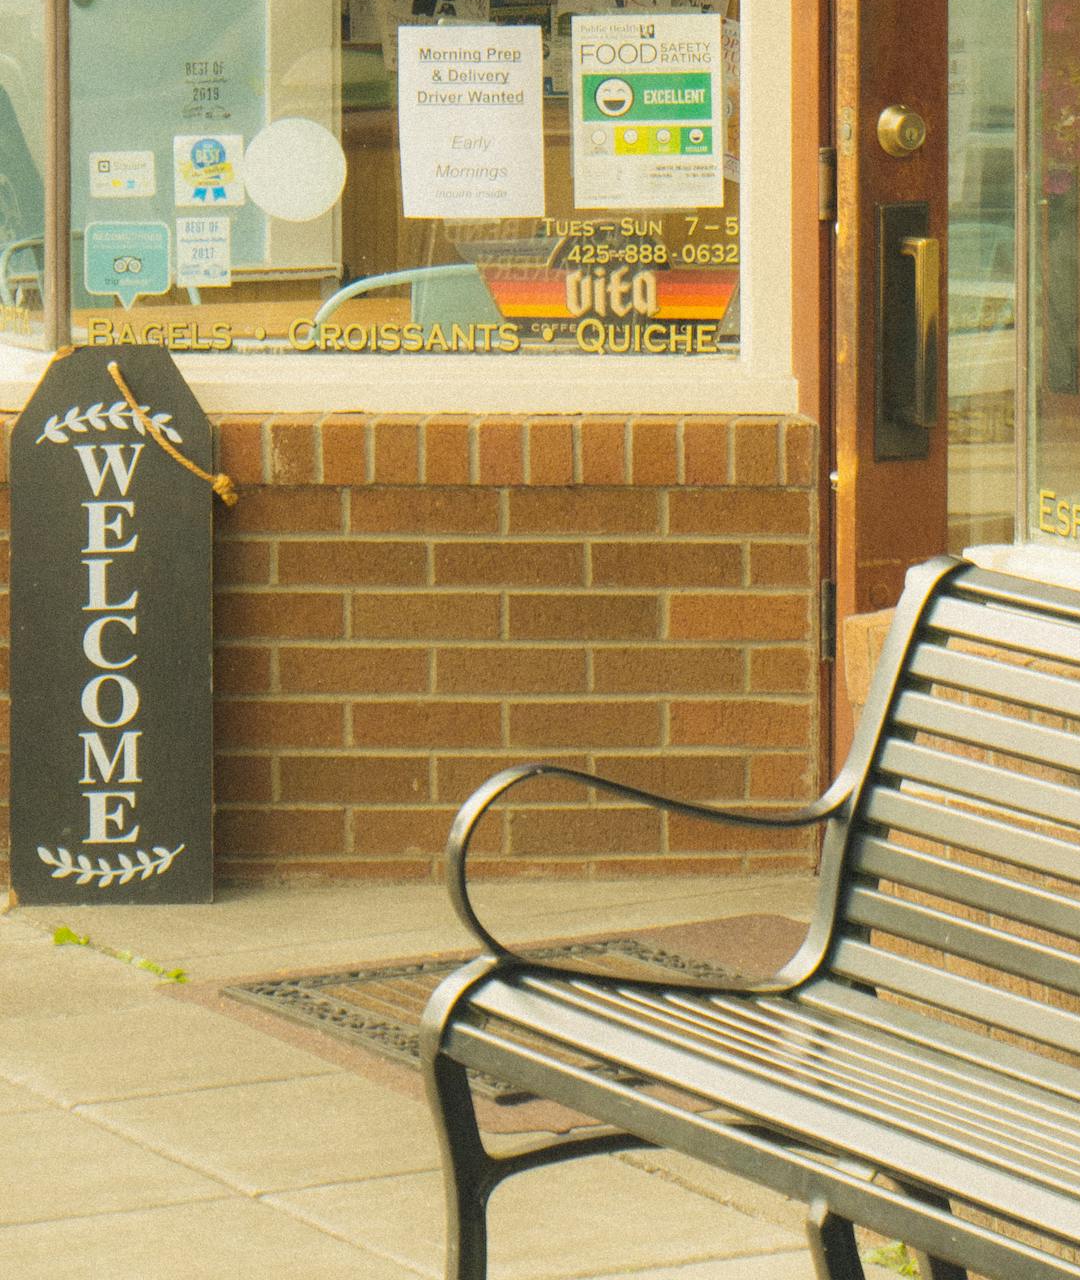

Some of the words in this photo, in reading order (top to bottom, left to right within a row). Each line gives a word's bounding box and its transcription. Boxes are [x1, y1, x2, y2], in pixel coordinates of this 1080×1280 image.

[419, 48, 482, 63] Morning
[487, 48, 522, 63] Prep
[580, 43, 658, 65] FOOD
[661, 42, 711, 52] SAFETY
[661, 53, 712, 64] RATING
[185, 62, 209, 76] BEST
[212, 61, 225, 75] OF
[432, 70, 442, 81] &
[448, 70, 510, 84] Delivery
[417, 91, 463, 103] Driver
[468, 90, 525, 103] Wanted
[643, 89, 706, 105] EXCELLENT
[452, 135, 491, 152] Early
[195, 148, 221, 163] BEST
[435, 163, 508, 181] Mornings
[185, 221, 206, 234] BEST
[208, 220, 220, 233] OF
[86, 317, 233, 351] BAGELS
[288, 317, 521, 352] CROISSANTS
[576, 317, 719, 357] QUICHE
[74, 443, 145, 844] WELCOME
